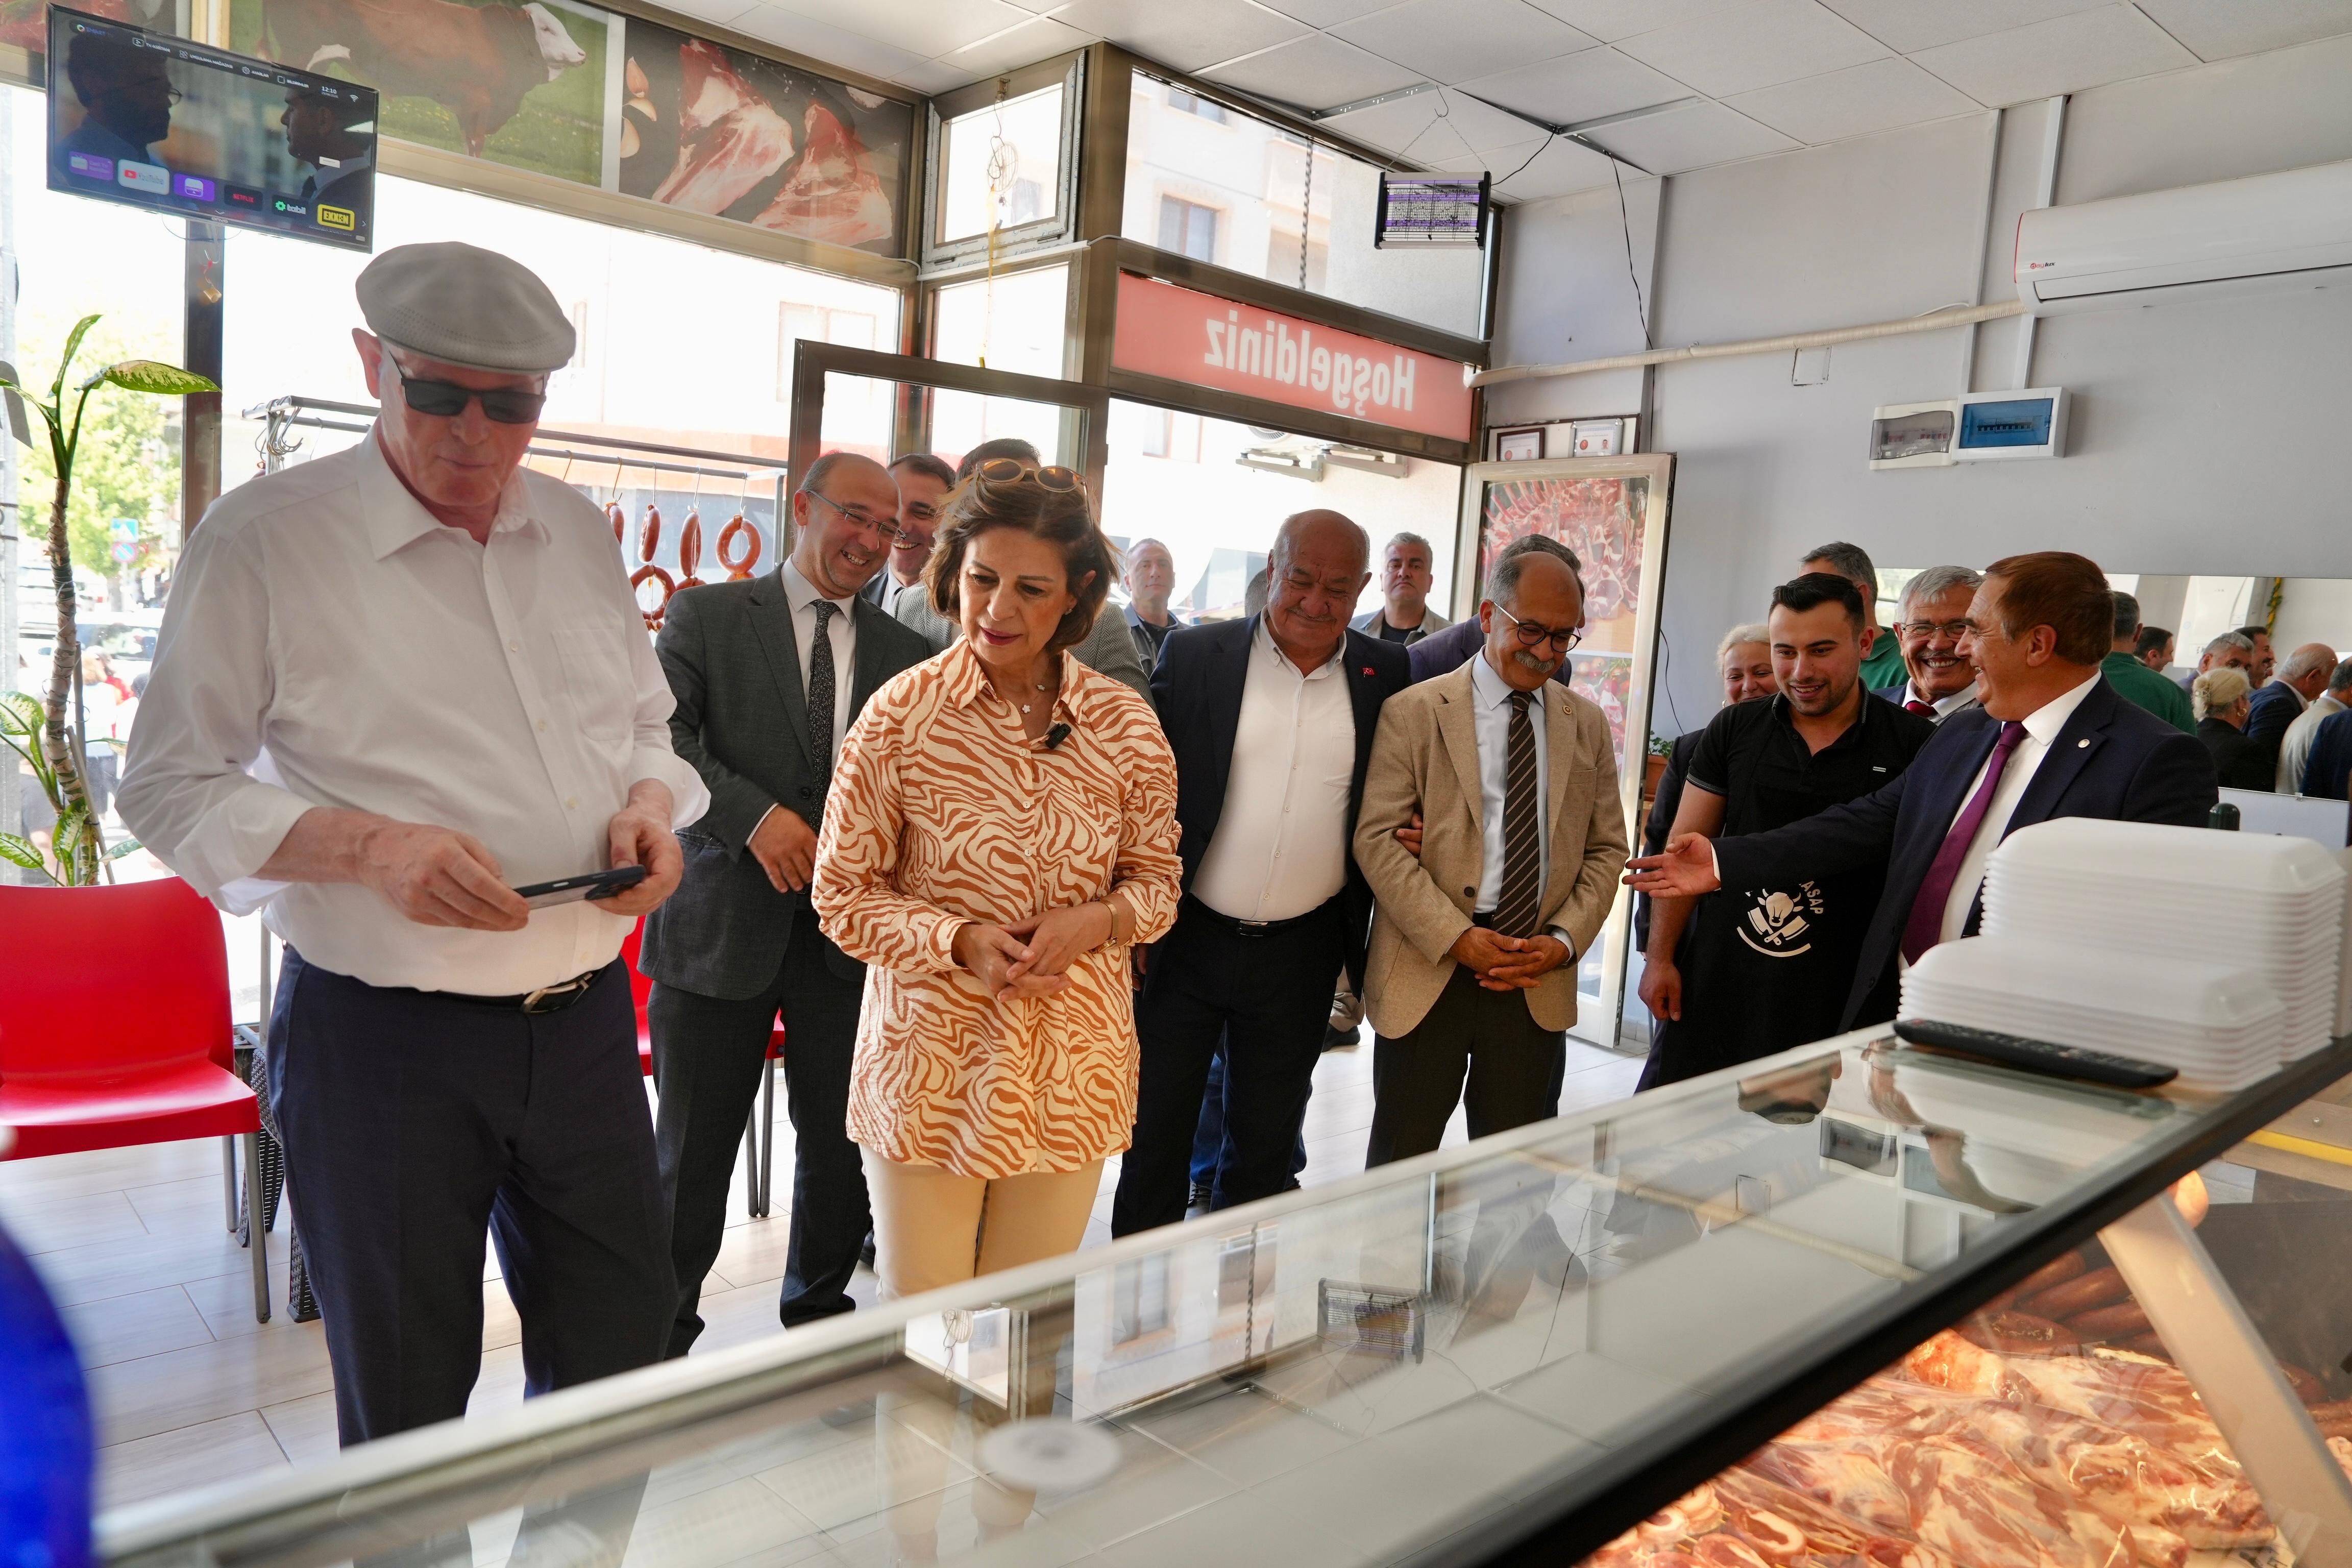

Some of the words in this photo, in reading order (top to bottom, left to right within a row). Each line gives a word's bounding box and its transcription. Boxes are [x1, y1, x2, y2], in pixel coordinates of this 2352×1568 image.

[322, 86, 337, 94] 12:10
[233, 193, 254, 203] NETFLIX
[323, 210, 349, 225] EXXEN
[1799, 880, 1824, 914] ASAP
